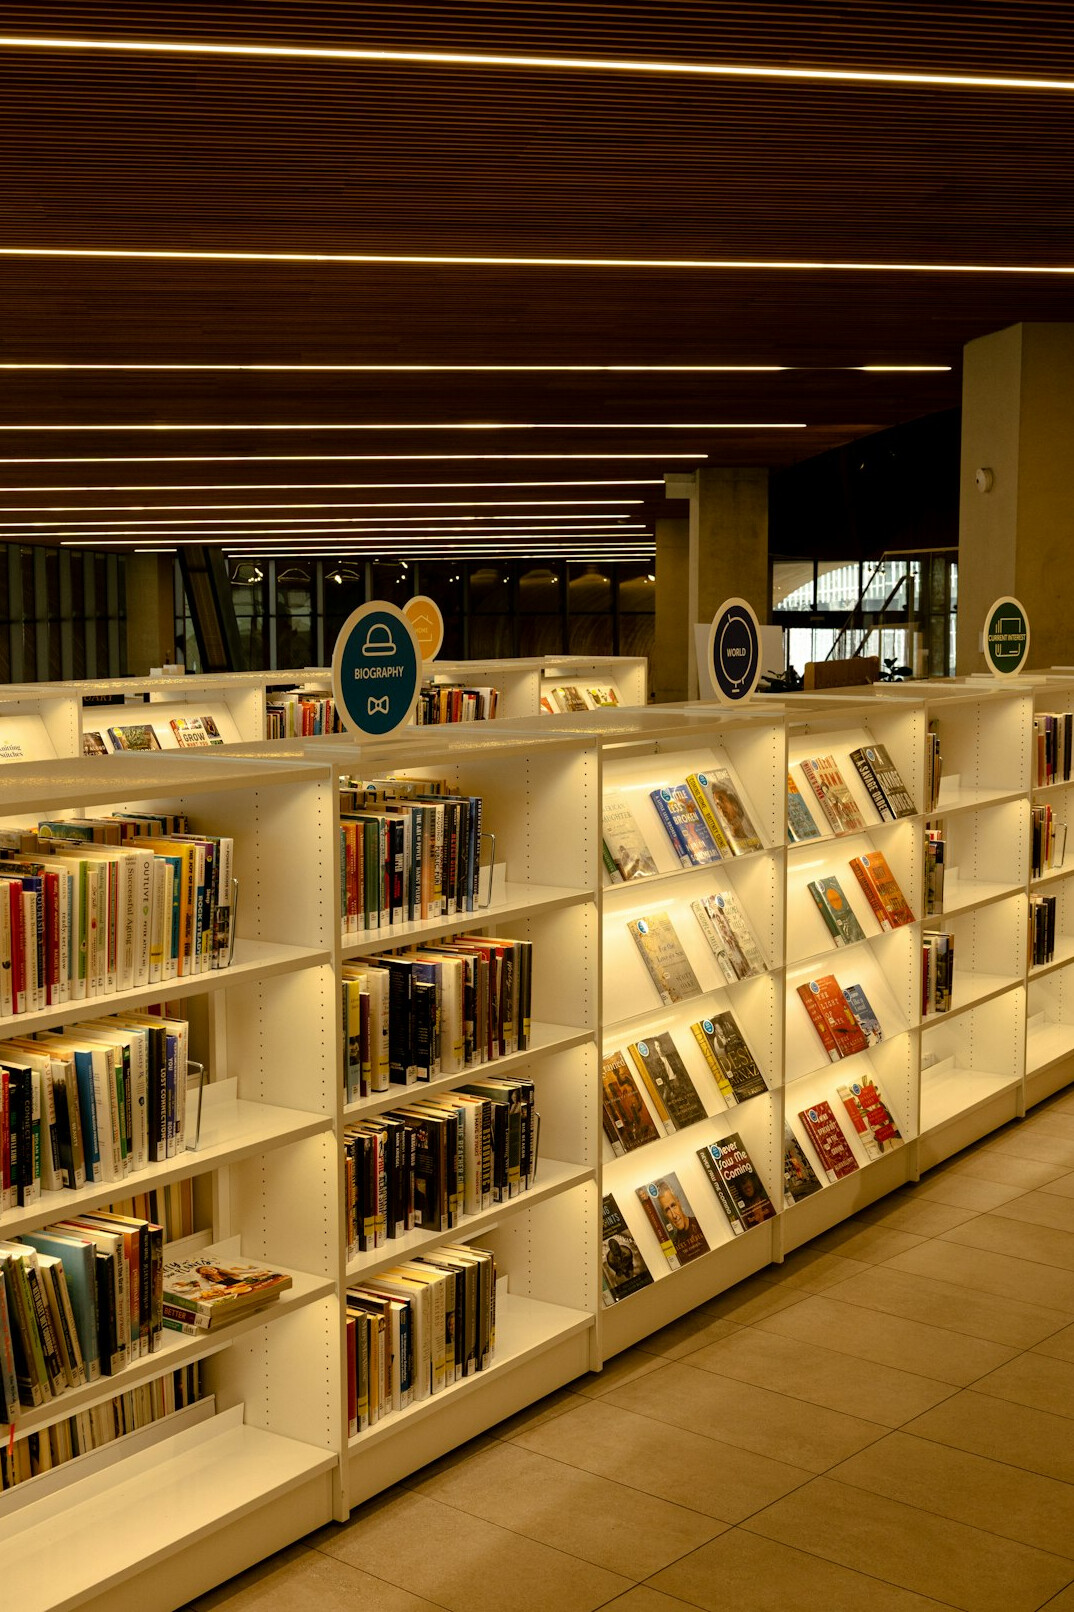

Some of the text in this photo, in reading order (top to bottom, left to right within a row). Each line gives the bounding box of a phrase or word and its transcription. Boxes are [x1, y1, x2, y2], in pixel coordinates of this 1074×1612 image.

[727, 648, 746, 657] WORLD
[355, 666, 404, 679] BIOGRAPHY
[183, 732, 206, 742] GROW
[860, 766, 878, 791] SAVAGE
[673, 812, 699, 825] BROKEN
[125, 868, 135, 945] Successful Aging
[821, 998, 840, 1009] LIGHT
[718, 1046, 754, 1073] DESI
[482, 1128, 490, 1186] ASTOUNDING
[734, 1151, 747, 1162] Me
[724, 1163, 752, 1180] Coming
[164, 1308, 186, 1319] BETTER
